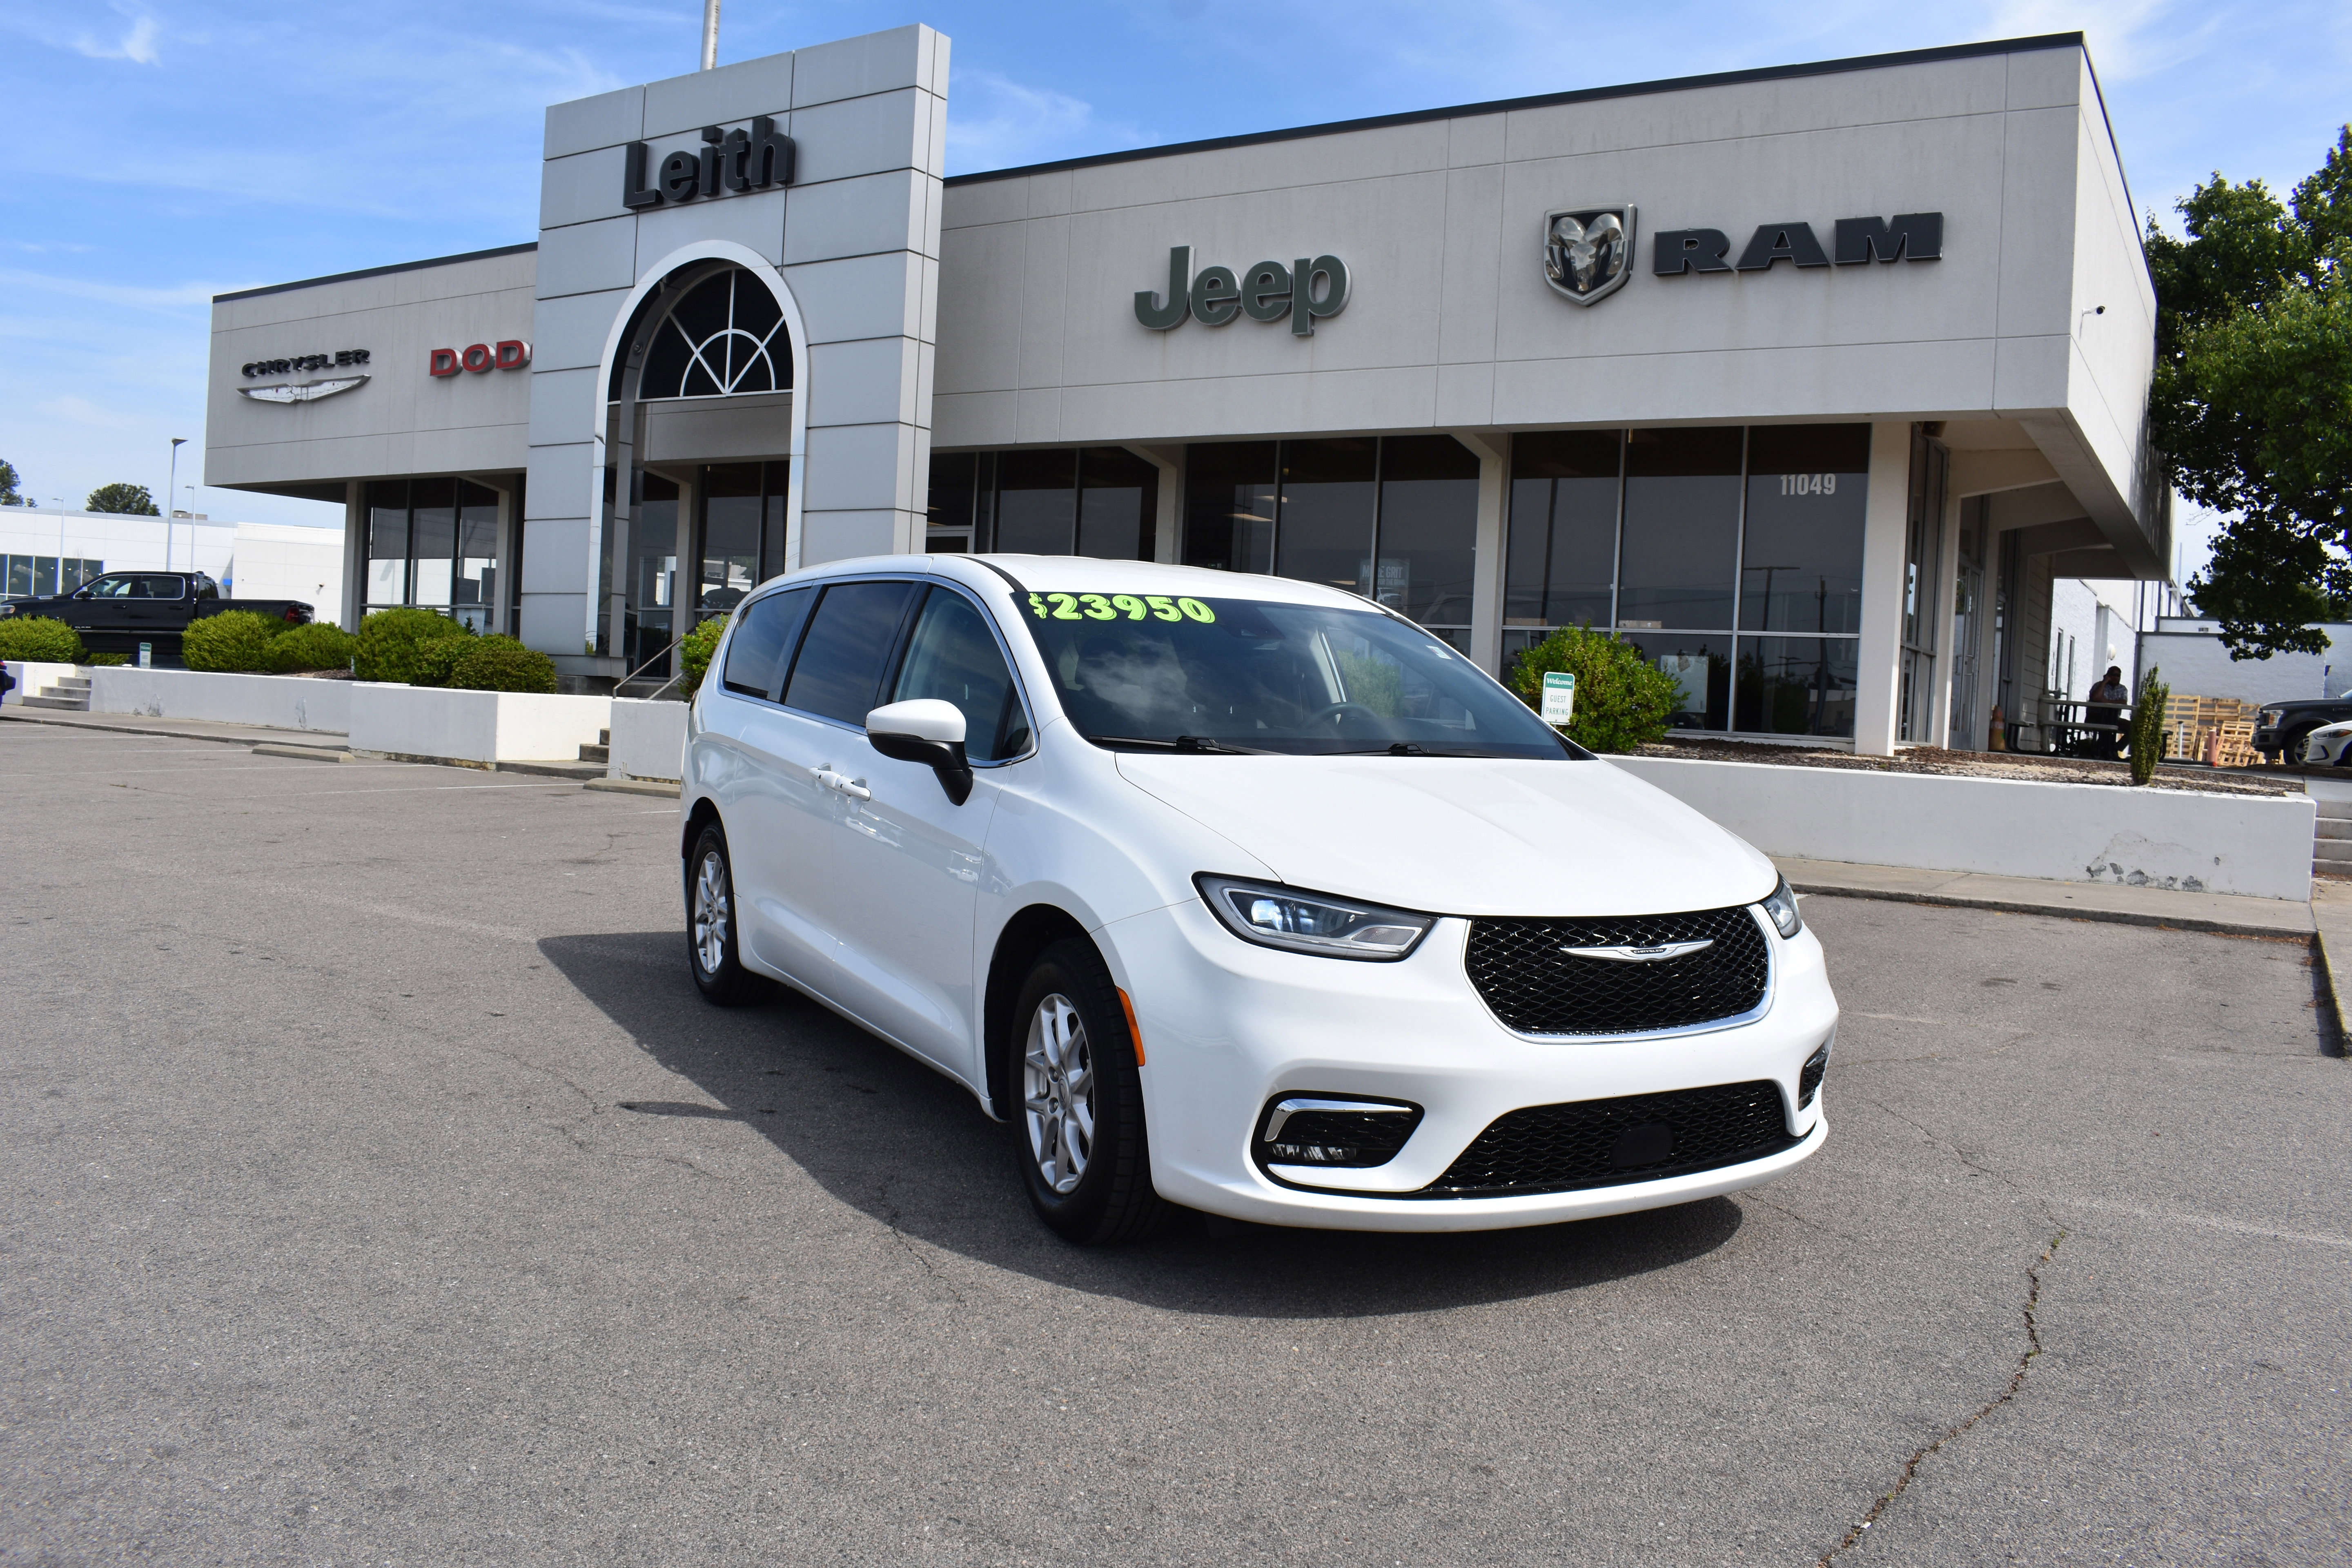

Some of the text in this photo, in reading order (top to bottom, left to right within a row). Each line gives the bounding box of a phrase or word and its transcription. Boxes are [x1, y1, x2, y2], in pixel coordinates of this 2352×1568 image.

[623, 116, 795, 209] Leith
[1654, 212, 1943, 275] RAM
[1134, 245, 1351, 336] Jeep
[242, 349, 370, 377] CHRYSLER
[430, 340, 532, 377] DOD
[1780, 474, 1836, 495] 11049
[1386, 566, 1403, 578] GRIT
[1028, 592, 1215, 623] $23950
[1546, 677, 1573, 686] Welcome
[1545, 707, 1569, 715] PARKING
